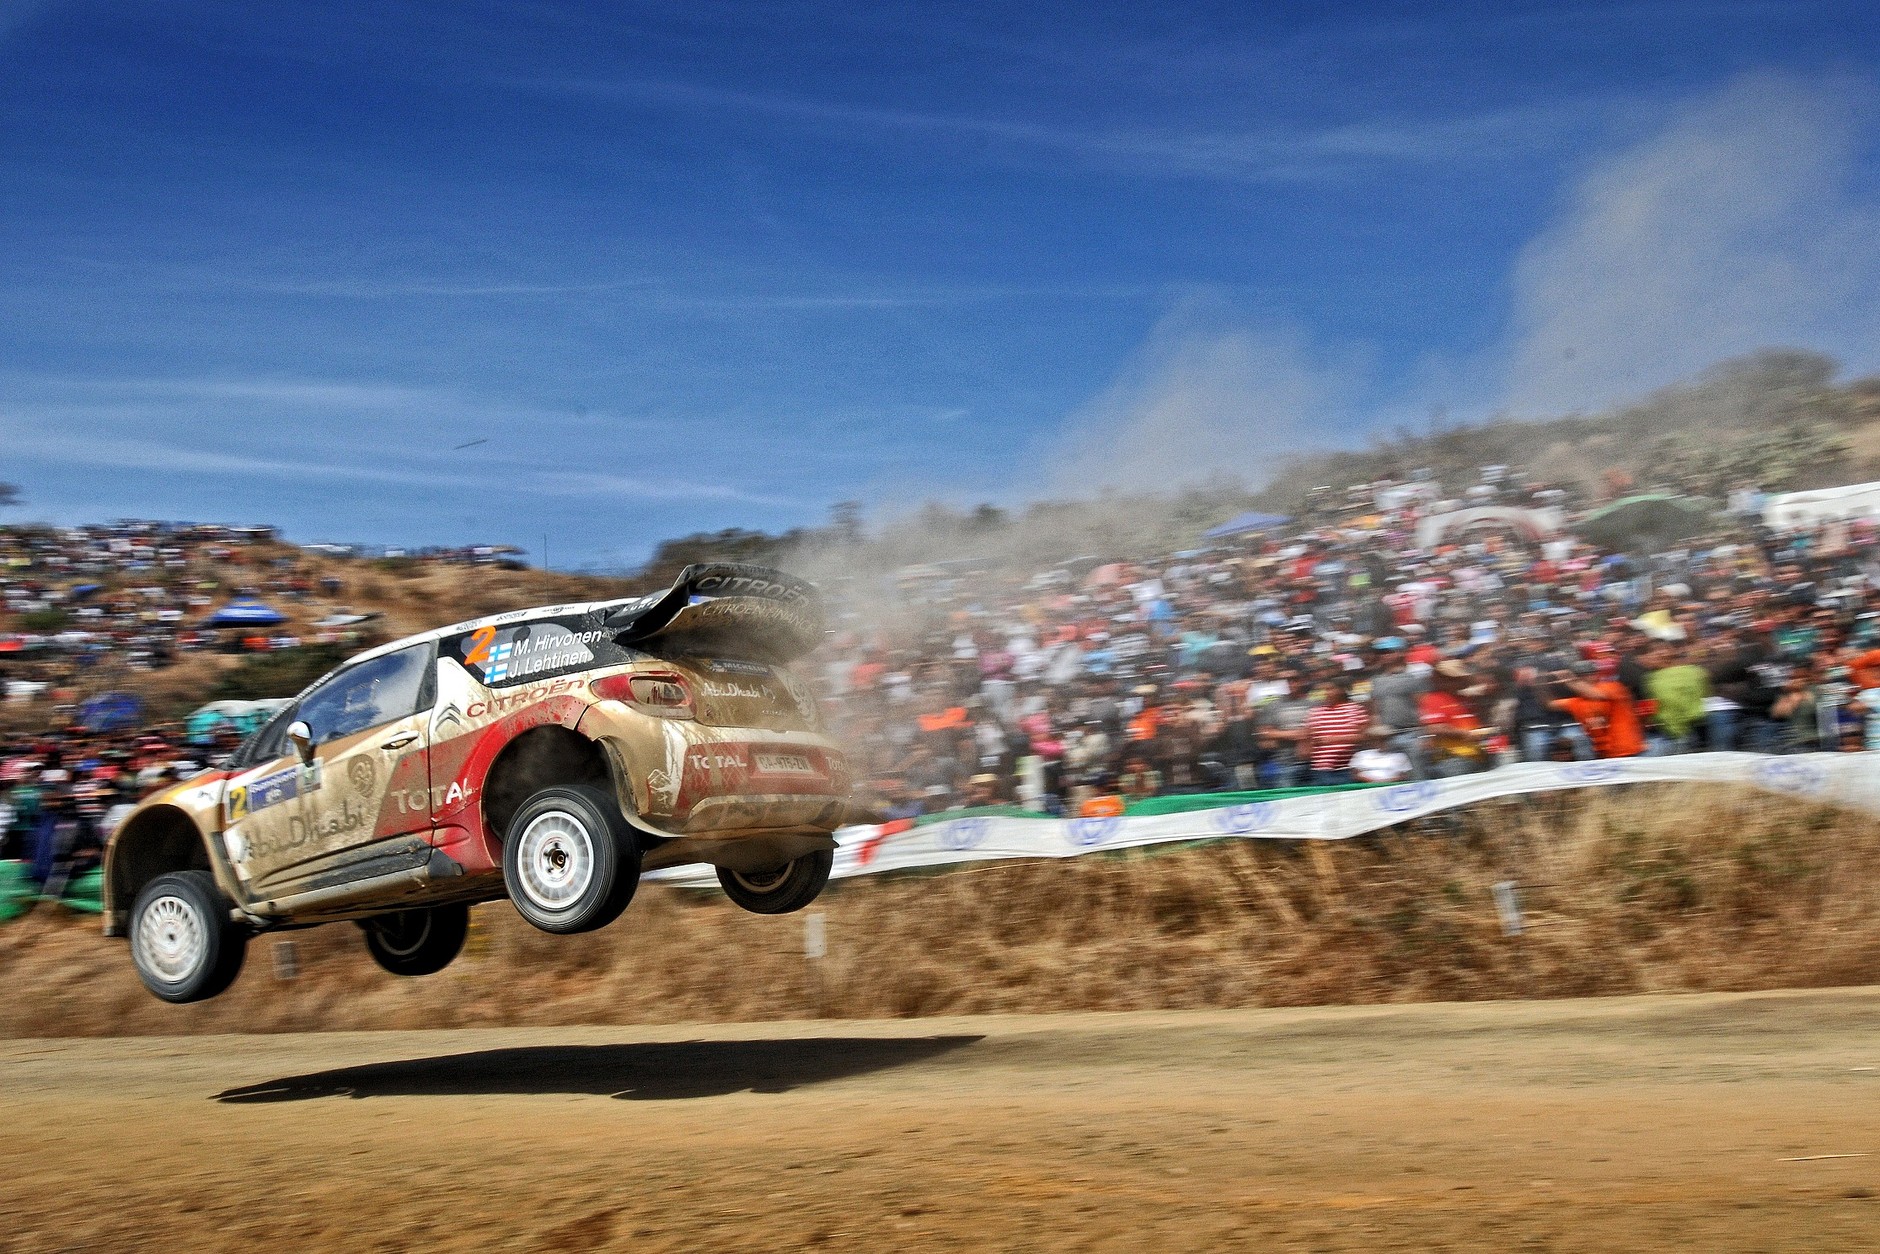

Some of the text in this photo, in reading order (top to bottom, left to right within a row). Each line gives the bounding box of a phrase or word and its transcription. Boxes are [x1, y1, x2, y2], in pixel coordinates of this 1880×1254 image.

[464, 625, 497, 666] 2
[513, 630, 602, 657] M. Hirvonen
[509, 651, 588, 679] J. Lehtinen
[727, 682, 761, 698] Dhabi
[230, 786, 249, 819] 2
[390, 778, 473, 814] TOTAL
[288, 798, 365, 847] Dhabi
